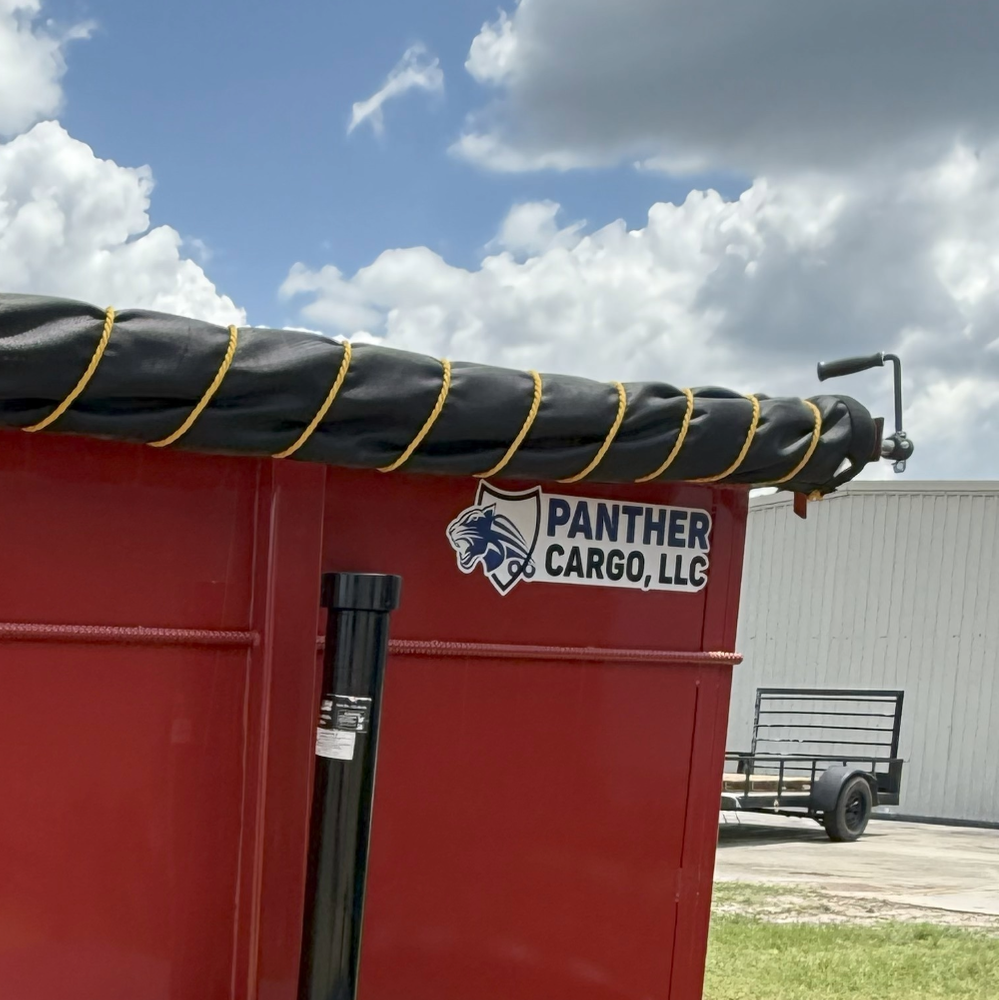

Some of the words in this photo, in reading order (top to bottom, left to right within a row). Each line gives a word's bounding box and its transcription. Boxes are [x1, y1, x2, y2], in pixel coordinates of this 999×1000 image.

[547, 498, 709, 550] PANTHER
[545, 544, 652, 588] CARGO,
[658, 553, 707, 588] LLC
